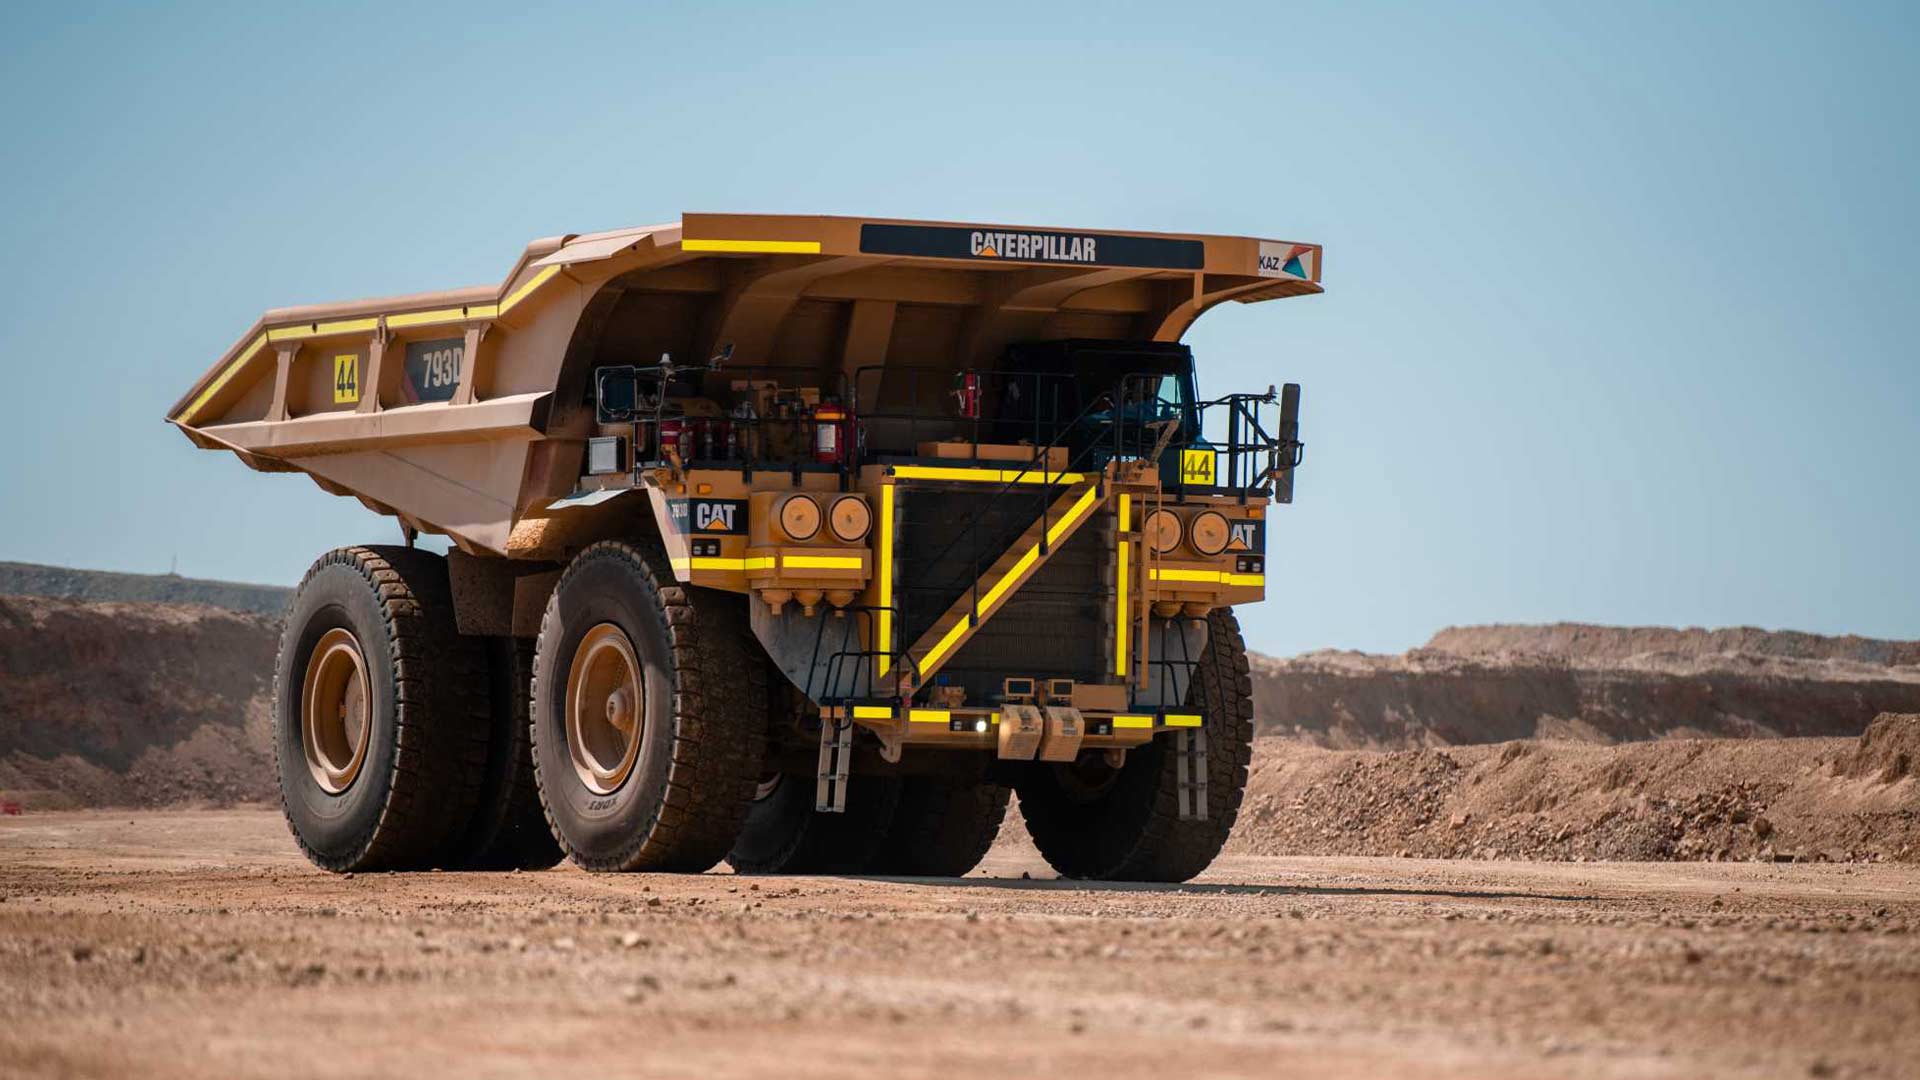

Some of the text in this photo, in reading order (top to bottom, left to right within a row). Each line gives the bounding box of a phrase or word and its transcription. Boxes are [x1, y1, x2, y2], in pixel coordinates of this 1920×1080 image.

[971, 231, 1096, 262] CATERPILLAR
[1259, 256, 1280, 270] KAZ
[336, 360, 356, 398] 44
[423, 347, 464, 388] 793D
[1184, 454, 1211, 481] 44
[697, 503, 737, 530] CAT
[1231, 524, 1256, 550] AT
